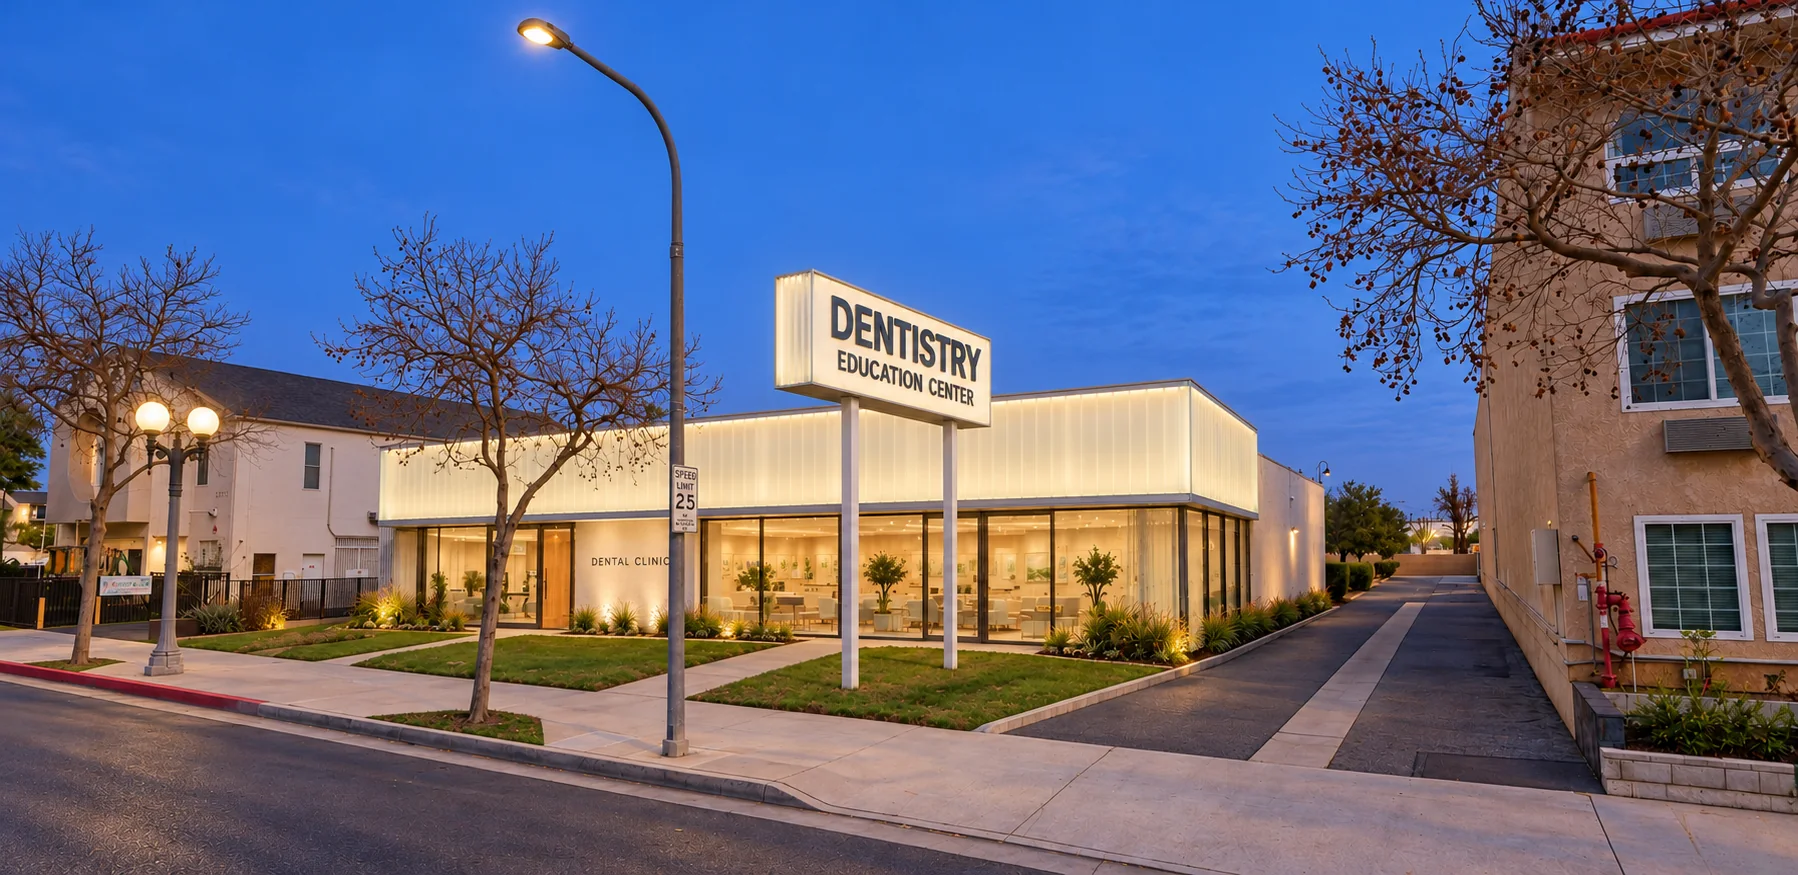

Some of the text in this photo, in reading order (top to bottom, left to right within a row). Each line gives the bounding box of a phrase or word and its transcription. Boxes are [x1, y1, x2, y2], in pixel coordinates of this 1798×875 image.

[831, 295, 982, 382] DENTISTRY
[837, 349, 974, 407] EDUCATION CENTER
[675, 470, 696, 480] SPEED
[676, 481, 694, 491] LIMIT
[675, 493, 695, 510] 25
[591, 556, 670, 566] DENTAL CLINIC
